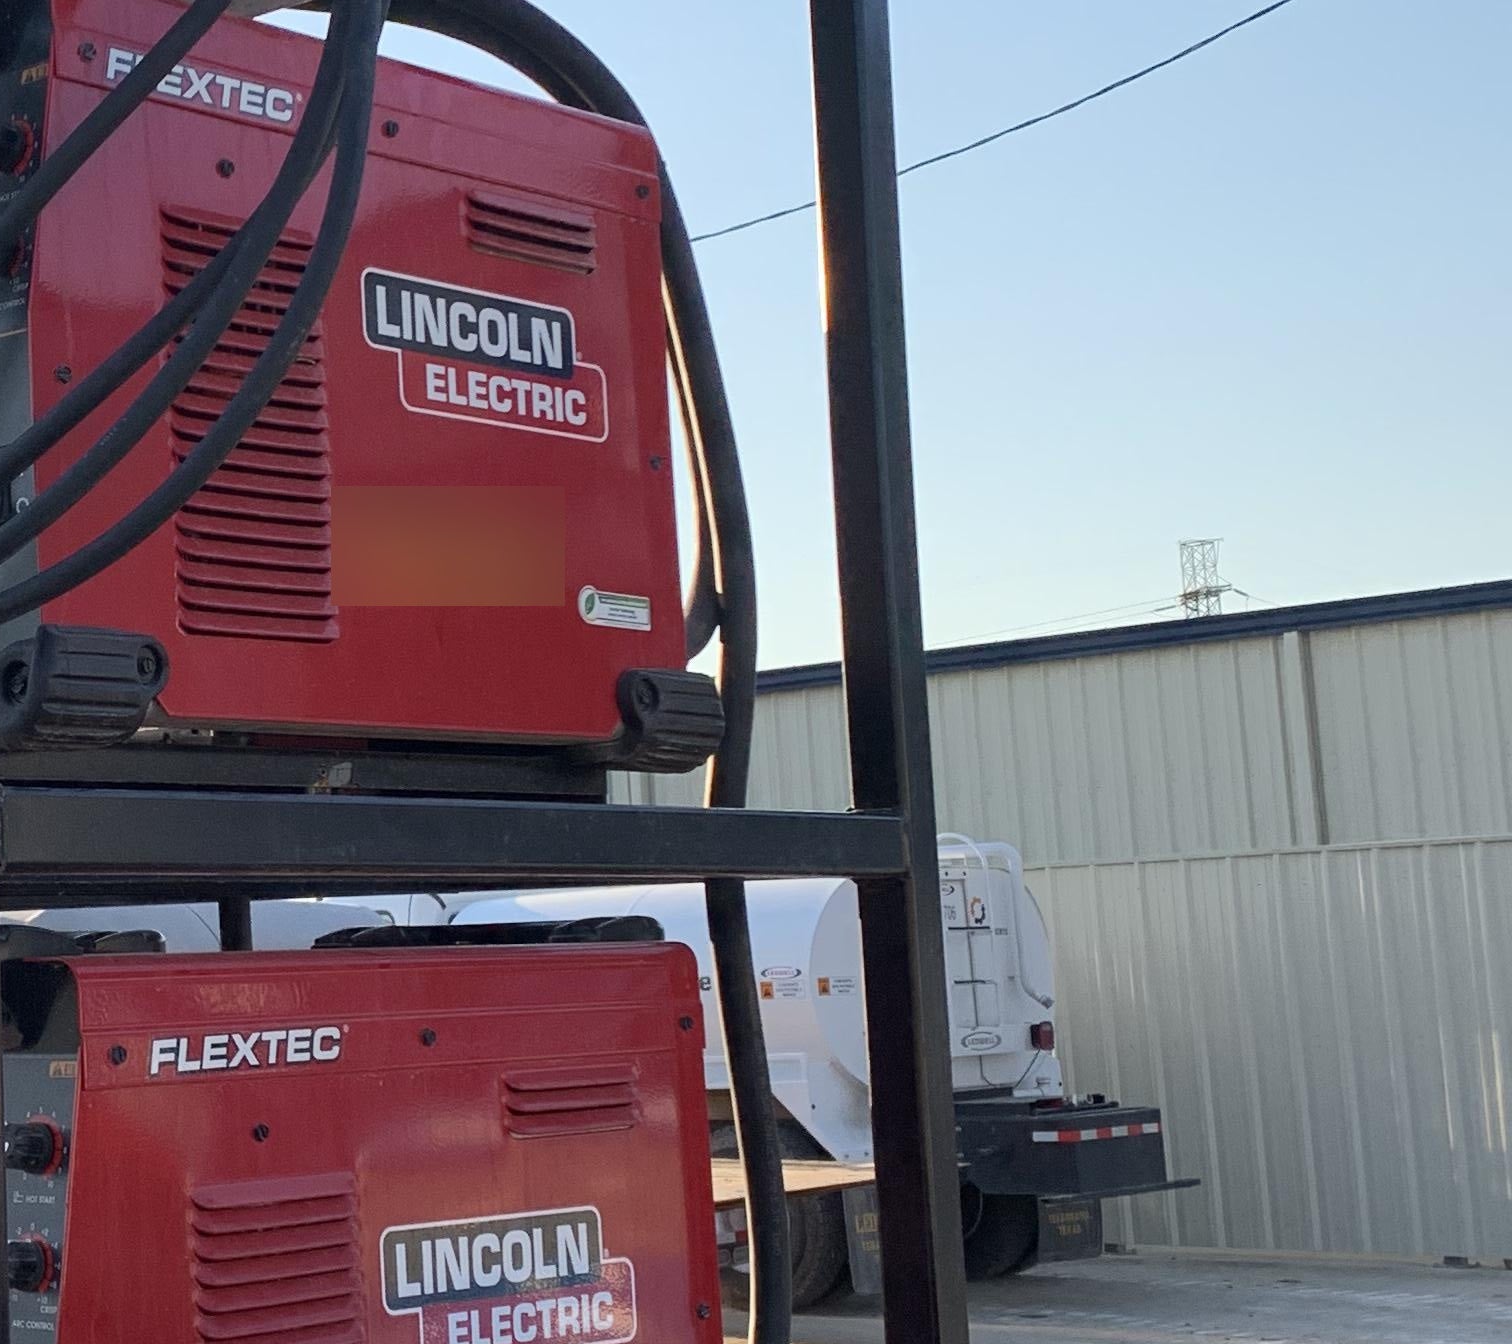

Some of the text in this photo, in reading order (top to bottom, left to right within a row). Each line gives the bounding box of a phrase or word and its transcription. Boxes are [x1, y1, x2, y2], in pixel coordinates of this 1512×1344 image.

[106, 47, 293, 122] FEXTEC
[375, 284, 563, 369] LINCOLN
[426, 363, 587, 426] ELECTRIC
[150, 1027, 340, 1074] FLEXTEC
[396, 1223, 589, 1298] LINCOLN
[26, 1320, 55, 1332] CONTROL
